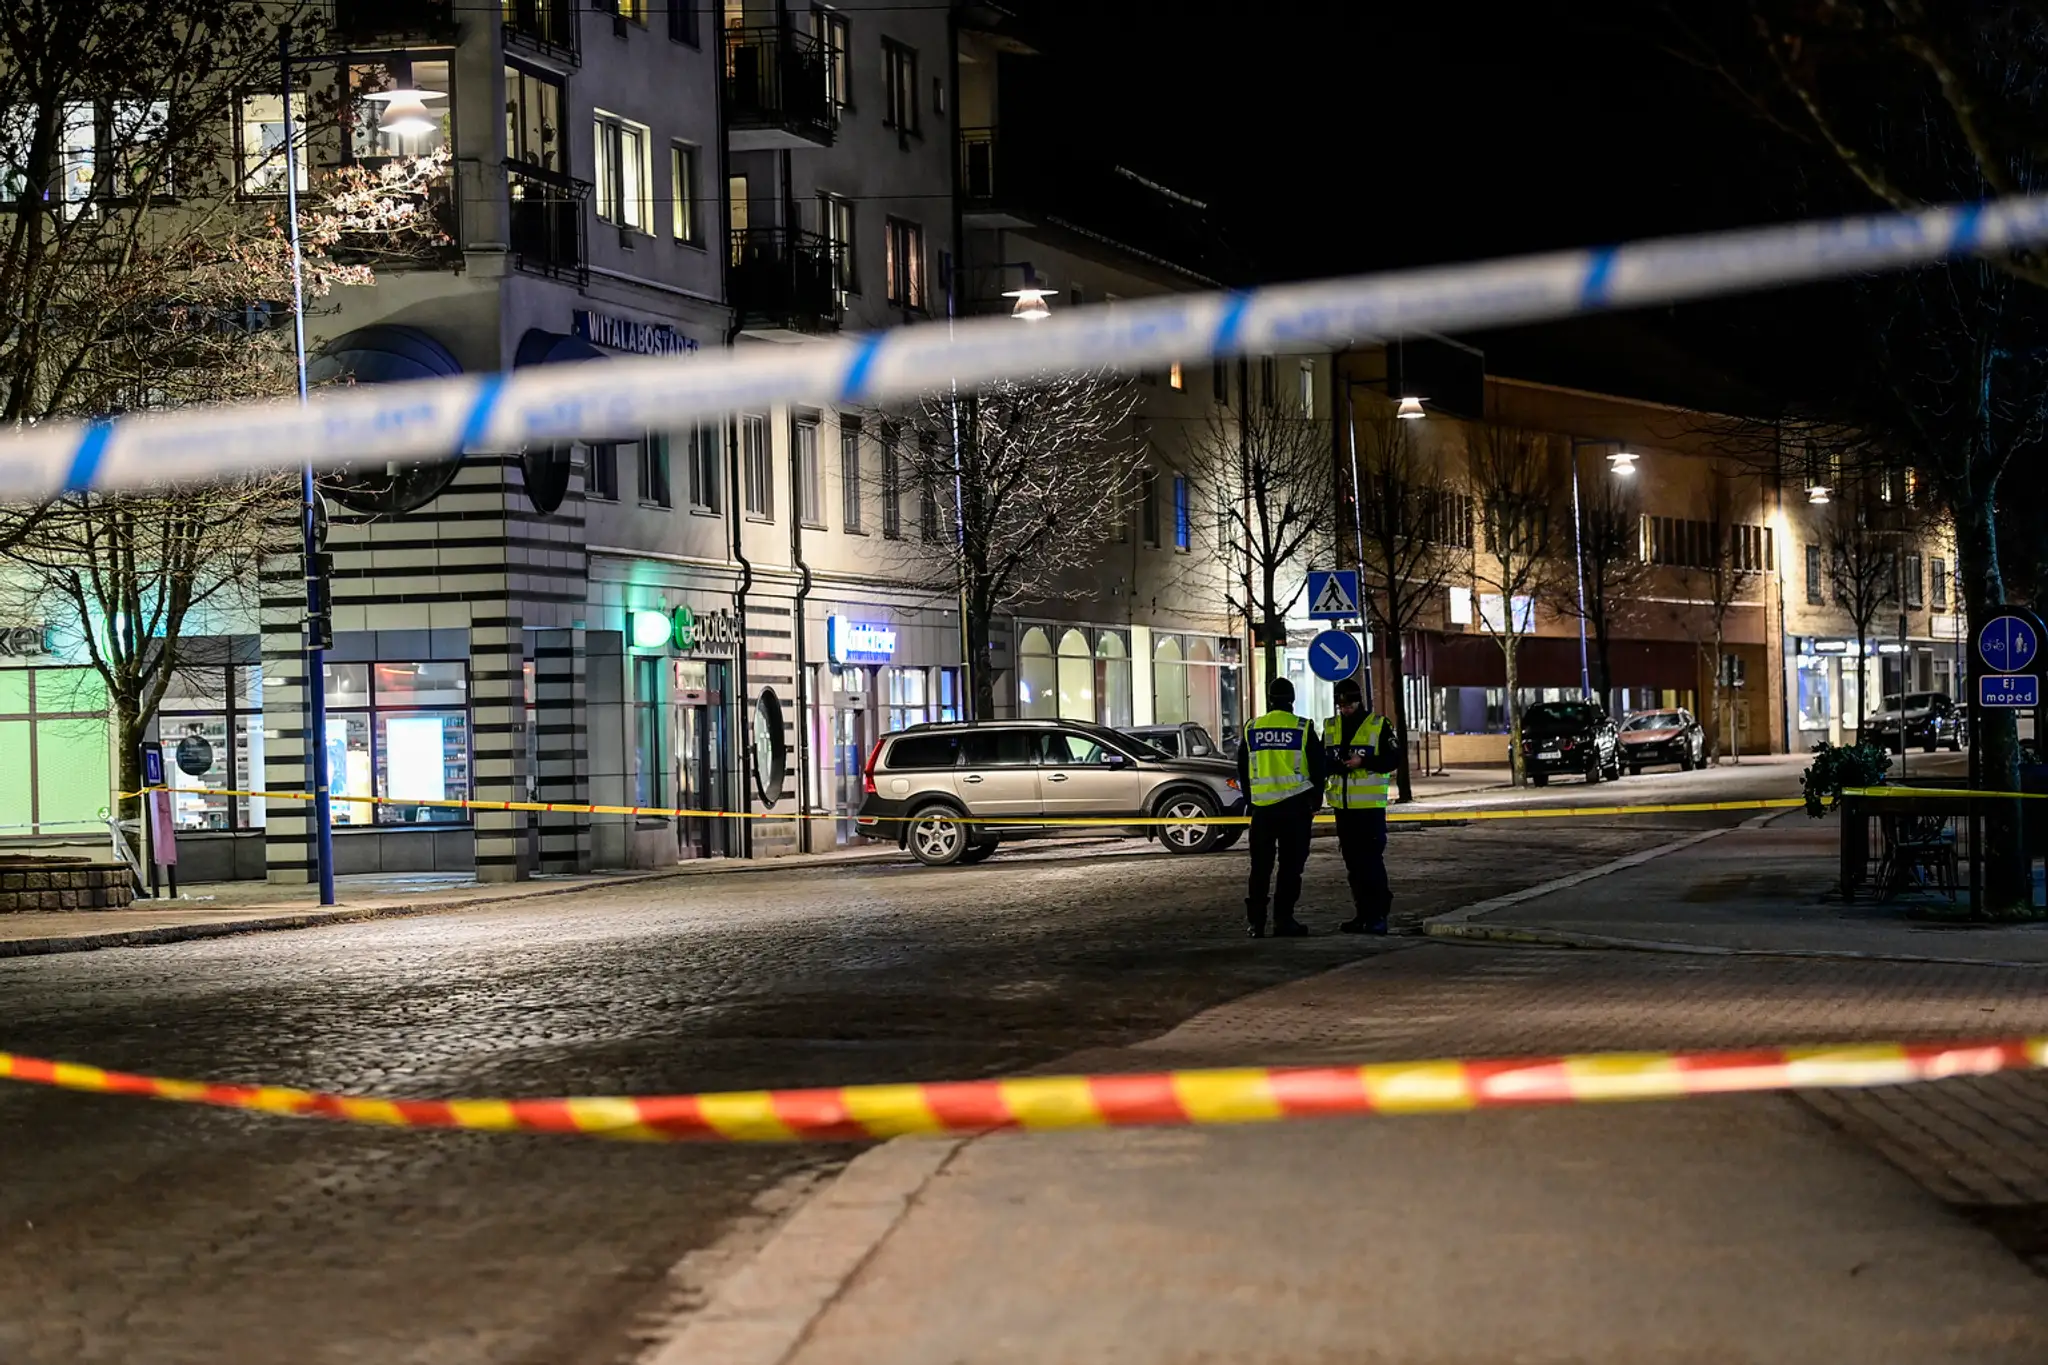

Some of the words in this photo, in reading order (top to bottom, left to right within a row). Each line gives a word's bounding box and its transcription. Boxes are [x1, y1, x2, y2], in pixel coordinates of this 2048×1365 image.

[2003, 678, 2015, 690] Ej
[1986, 692, 2032, 704] moped
[1255, 731, 1293, 744] POLIS
